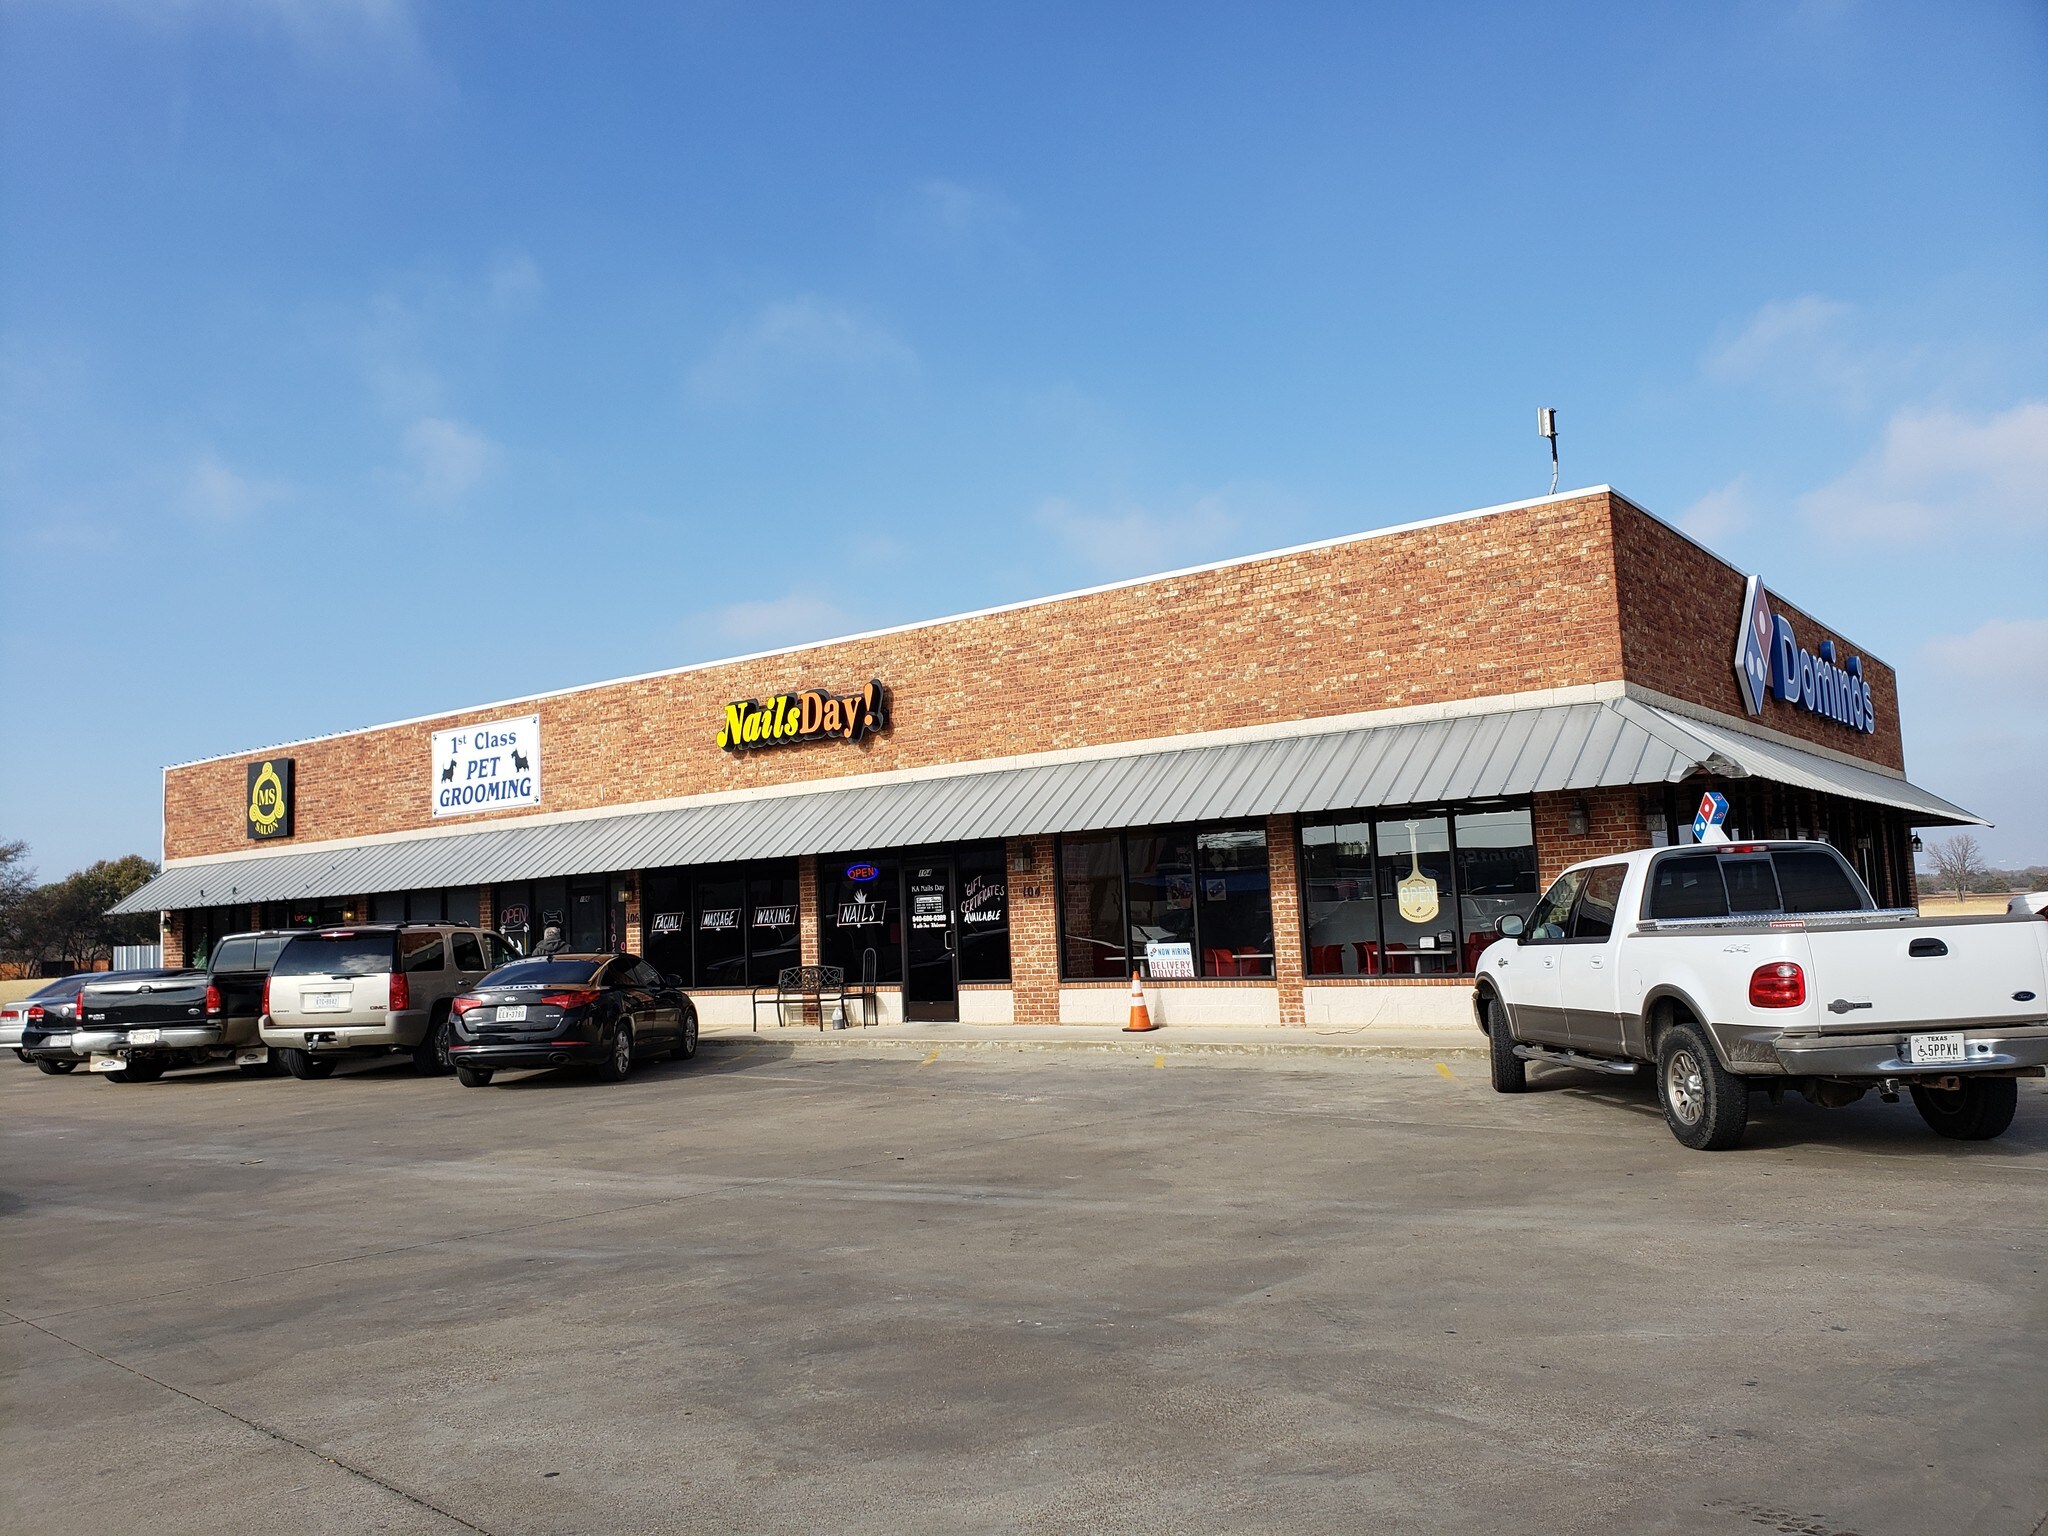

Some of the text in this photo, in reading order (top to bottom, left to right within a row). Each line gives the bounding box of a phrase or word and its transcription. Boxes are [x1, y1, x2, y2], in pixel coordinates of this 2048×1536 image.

[1773, 613, 1875, 735] Domino's
[450, 731, 517, 754] 1st Class
[466, 756, 501, 780] PET
[258, 788, 276, 805] MS
[440, 777, 532, 807] GROOMING
[255, 820, 279, 835] SALON
[848, 867, 874, 880] OPEN
[934, 884, 945, 892] Day
[966, 876, 981, 896] GIFT
[960, 884, 1005, 914] CERTIFICATES
[1400, 886, 1436, 903] OPEN
[501, 907, 527, 923] OPEN
[627, 913, 640, 923] 106
[703, 911, 735, 926] MASSAGE
[757, 908, 791, 924] WAXING
[842, 904, 875, 922] NAILS
[964, 909, 1002, 924] AVAILABLE
[655, 914, 679, 929] FACIAL
[1157, 947, 1190, 956] NOW HIRING
[1151, 960, 1191, 970] DELIVERY
[1152, 969, 1193, 978] DRIVERS
[1927, 1043, 1959, 1057] 5PPXH
